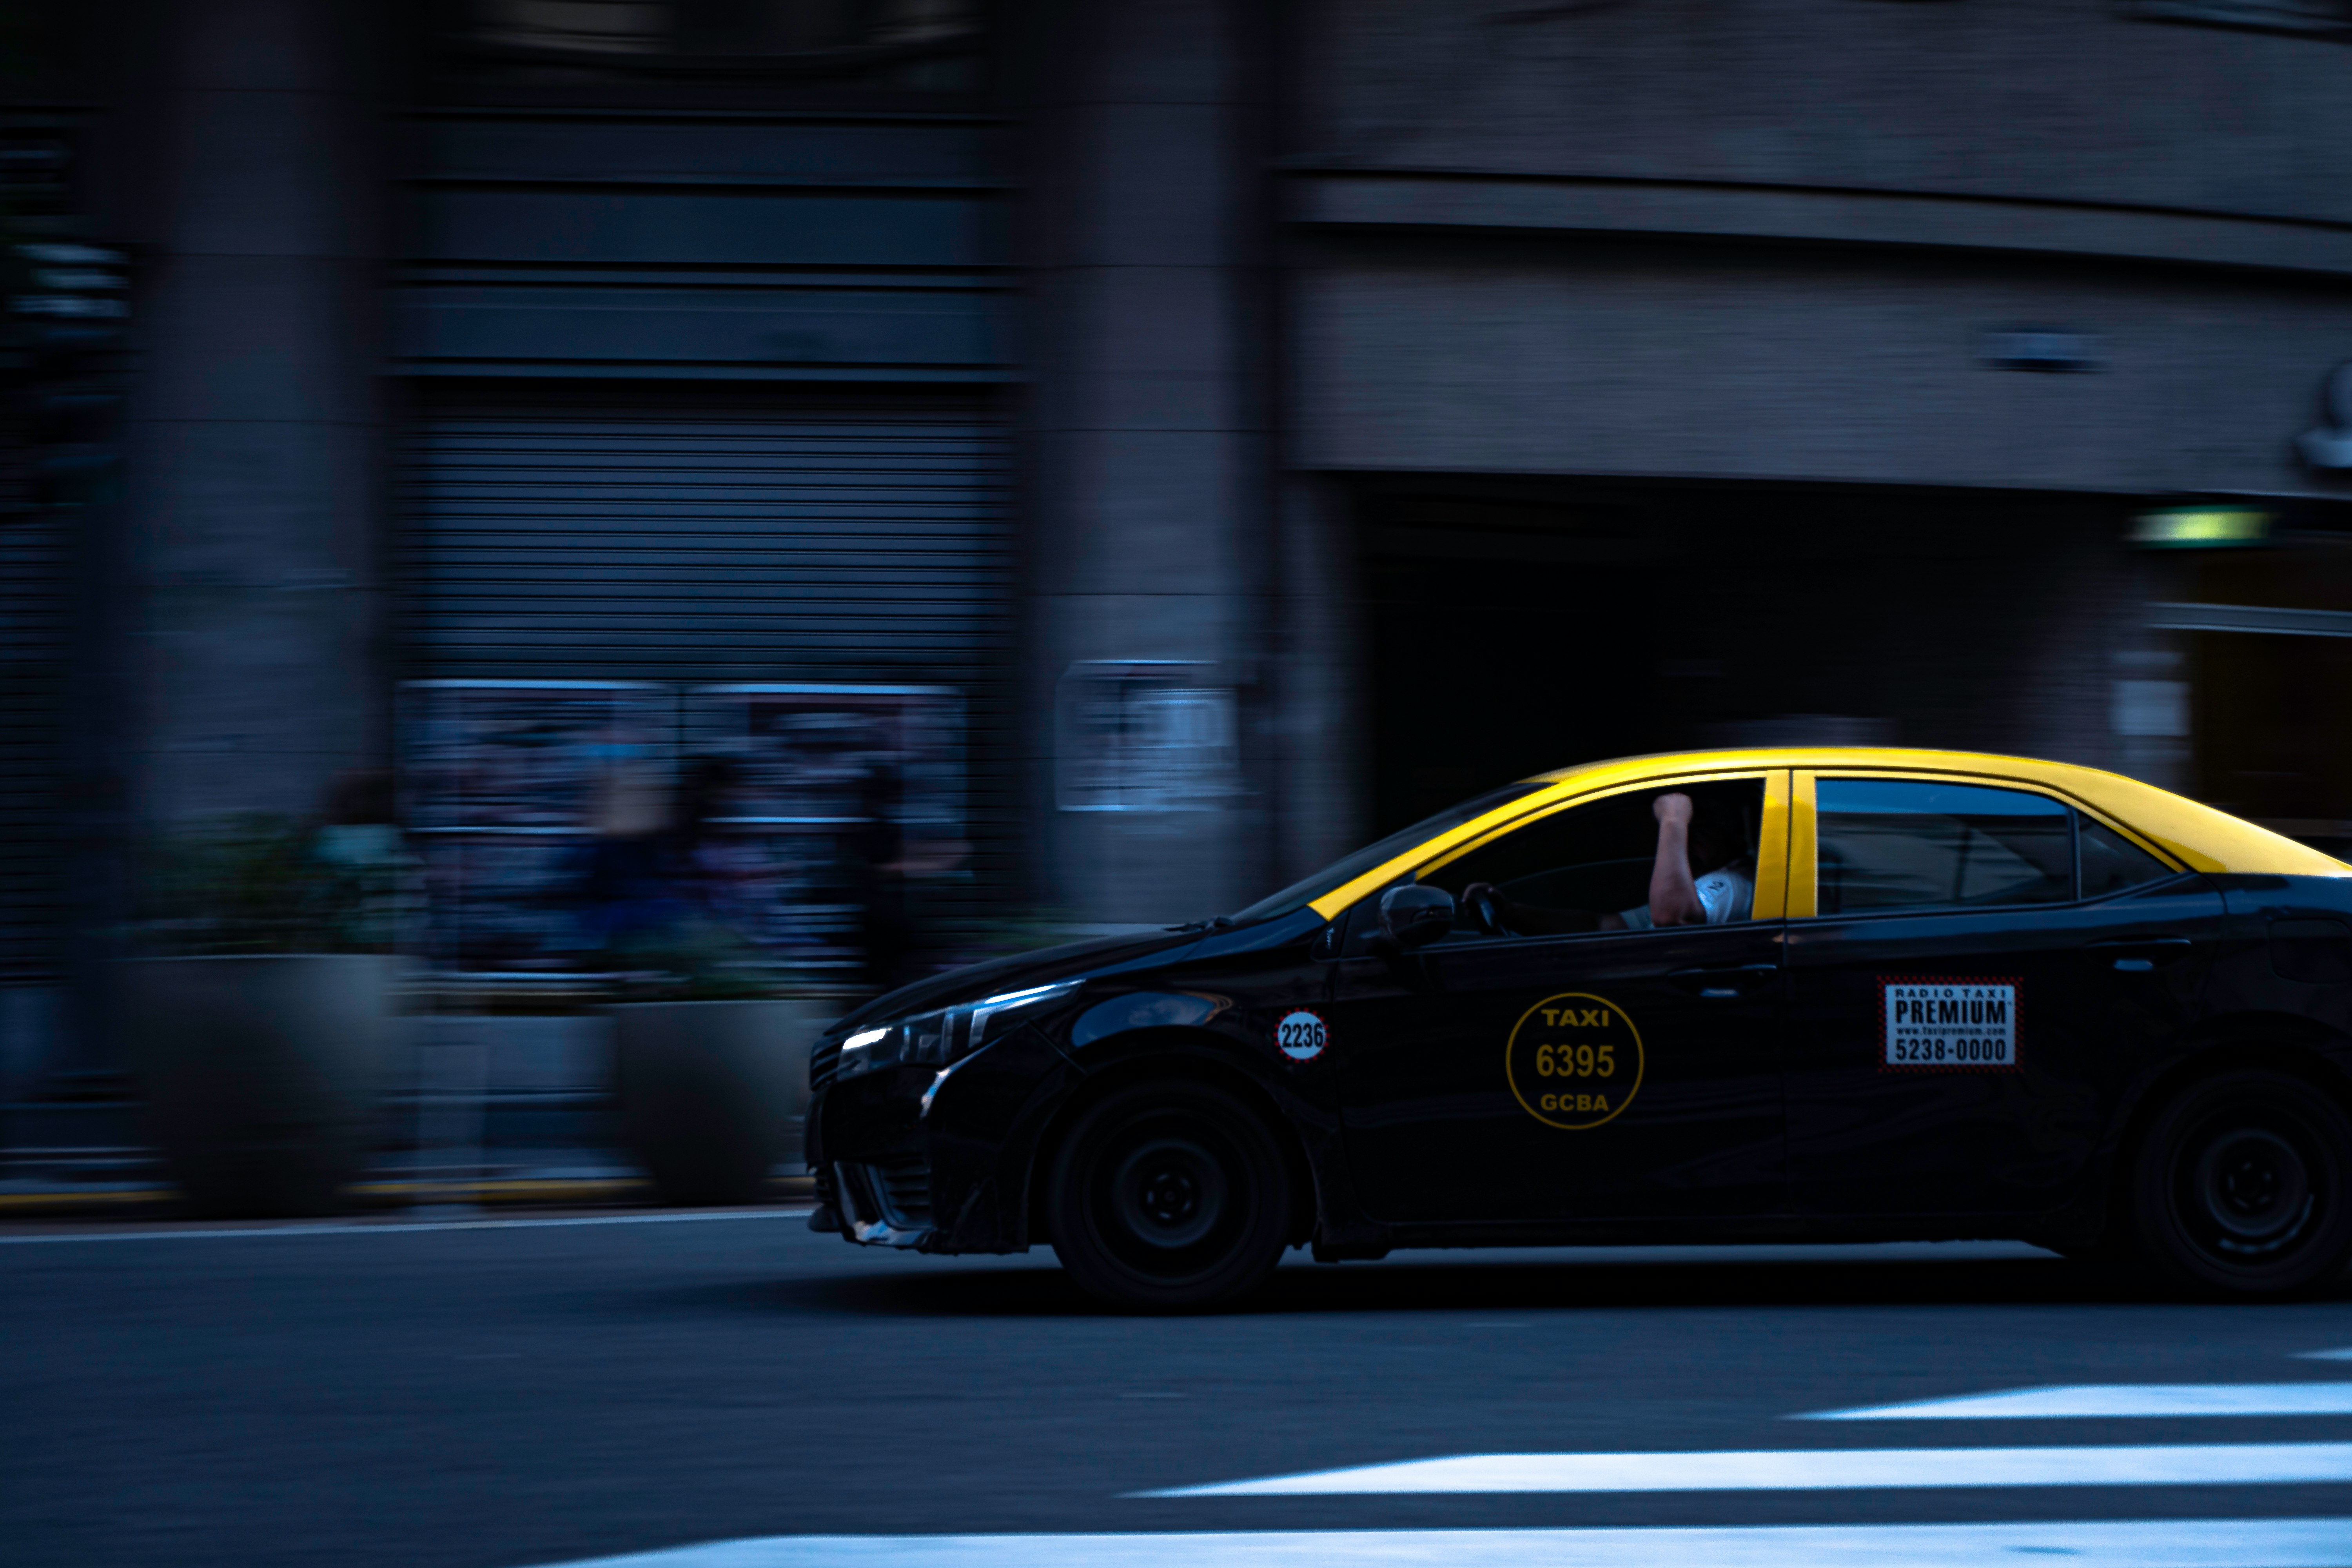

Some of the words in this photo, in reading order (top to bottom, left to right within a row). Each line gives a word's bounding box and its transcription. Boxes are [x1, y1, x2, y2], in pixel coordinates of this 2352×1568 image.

[1895, 989, 1954, 998] RADIO
[1962, 989, 2006, 998] TAXI
[1540, 1009, 1610, 1027] TAXI
[1896, 1000, 2006, 1024] PREMIUM
[1282, 1022, 1323, 1047] 2236
[1896, 1027, 2006, 1037] www.taxipremium.com
[1896, 1039, 2006, 1060] 5238-0000
[1535, 1044, 1615, 1078] 6395
[1540, 1093, 1610, 1112] GCBA
